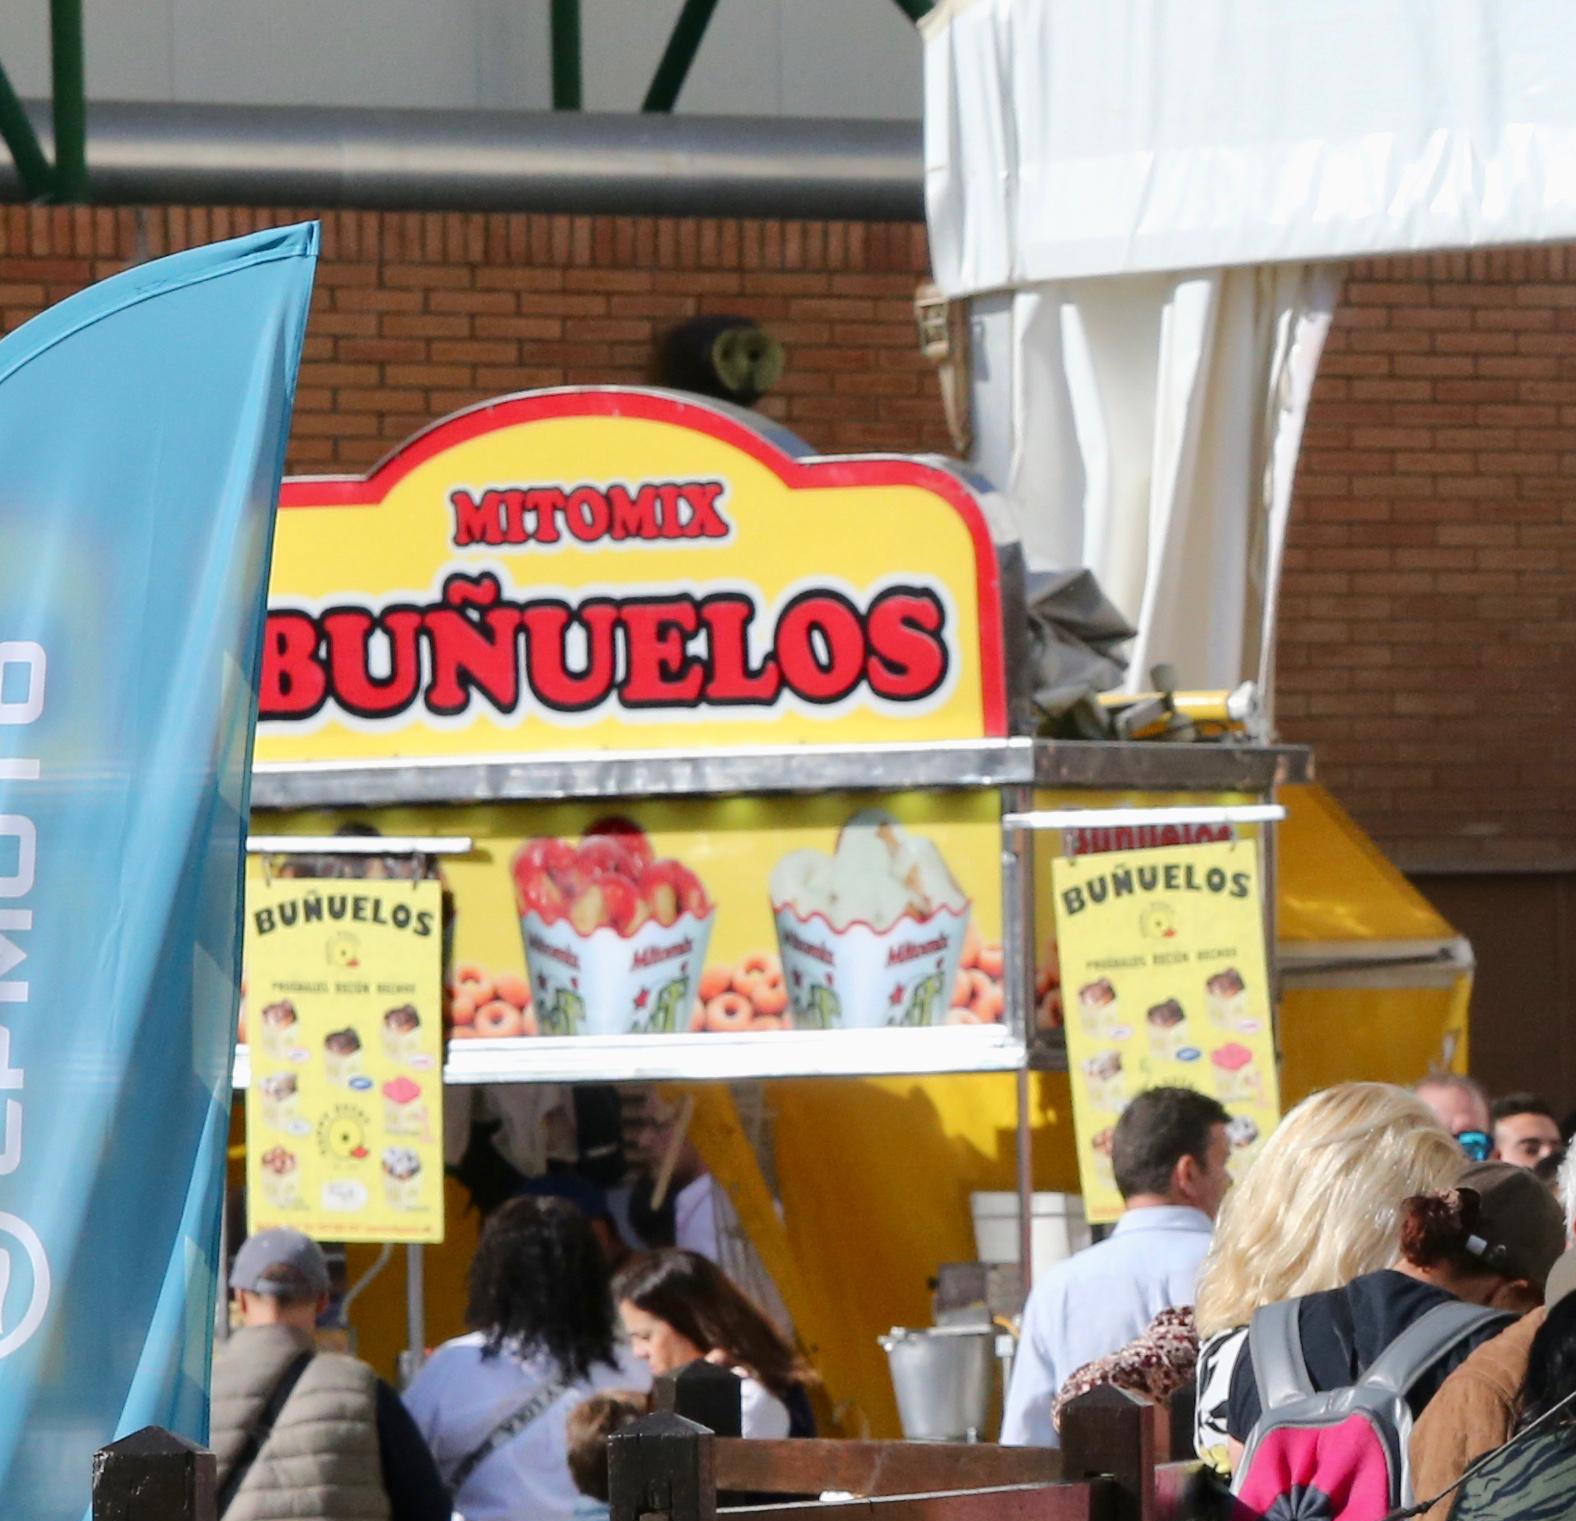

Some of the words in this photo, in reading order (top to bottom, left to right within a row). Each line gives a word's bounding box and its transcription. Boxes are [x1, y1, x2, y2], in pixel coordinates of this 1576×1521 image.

[450, 482, 730, 546] MITOMIX
[258, 571, 950, 720] BUÑUELOS
[255, 890, 434, 938] BUÑUELOS
[1061, 863, 1250, 916] BUÑUELOS
